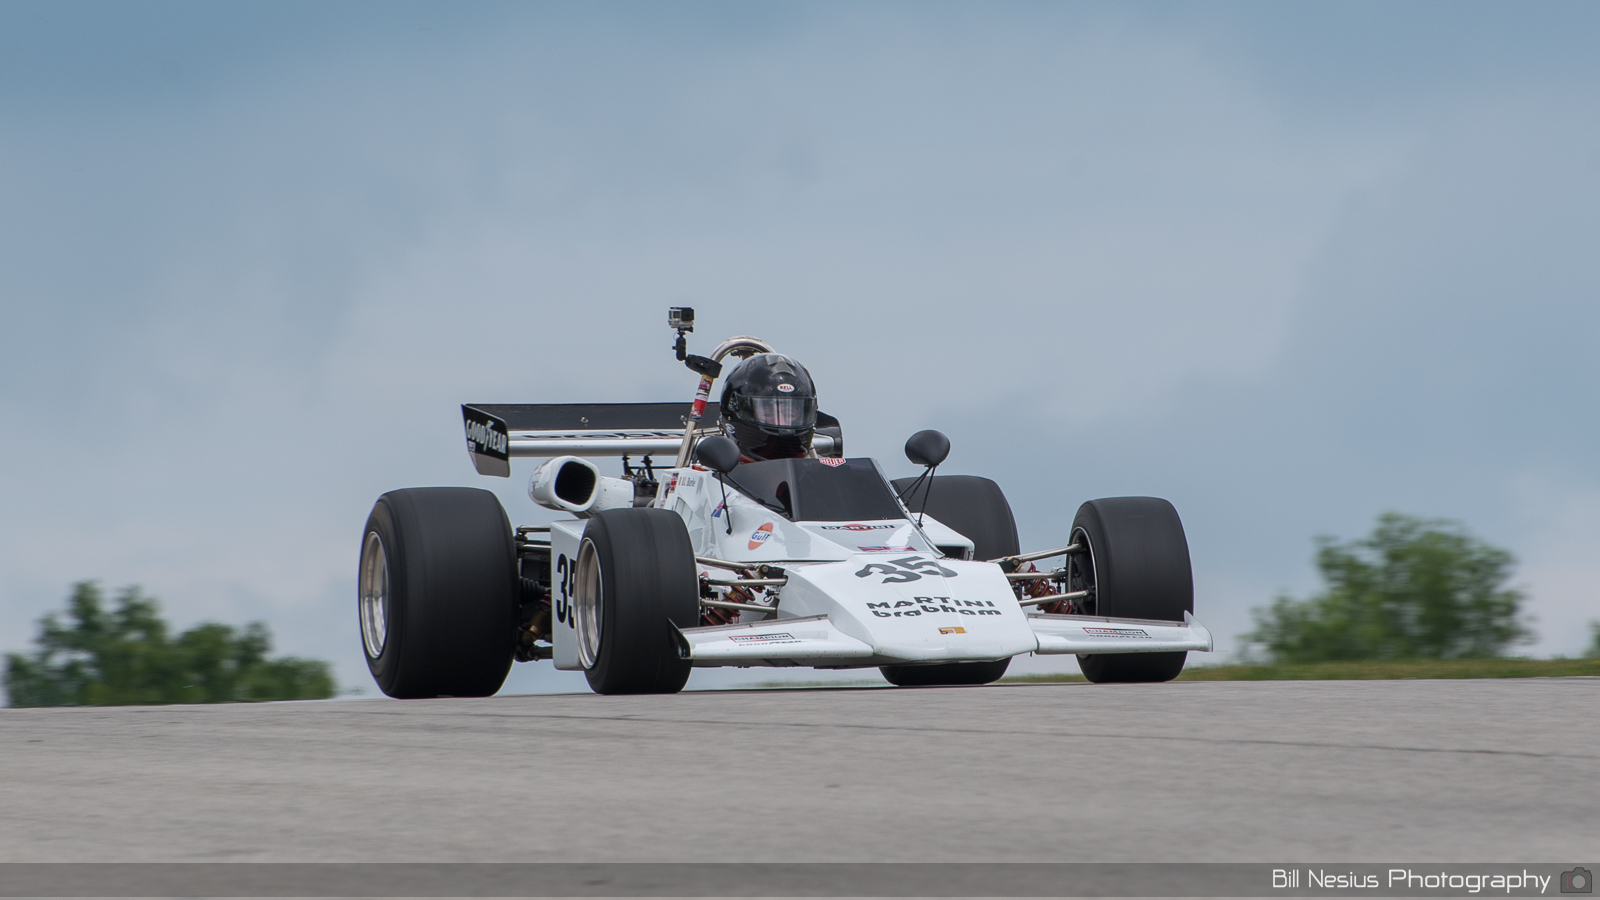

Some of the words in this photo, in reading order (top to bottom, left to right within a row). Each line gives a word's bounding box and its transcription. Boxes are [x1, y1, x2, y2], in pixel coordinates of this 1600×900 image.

[466, 419, 507, 454] GOODYEAR
[751, 531, 772, 543] Gulf
[855, 556, 958, 584] 35
[866, 596, 995, 610] MARTINI
[872, 605, 1002, 618] brabham
